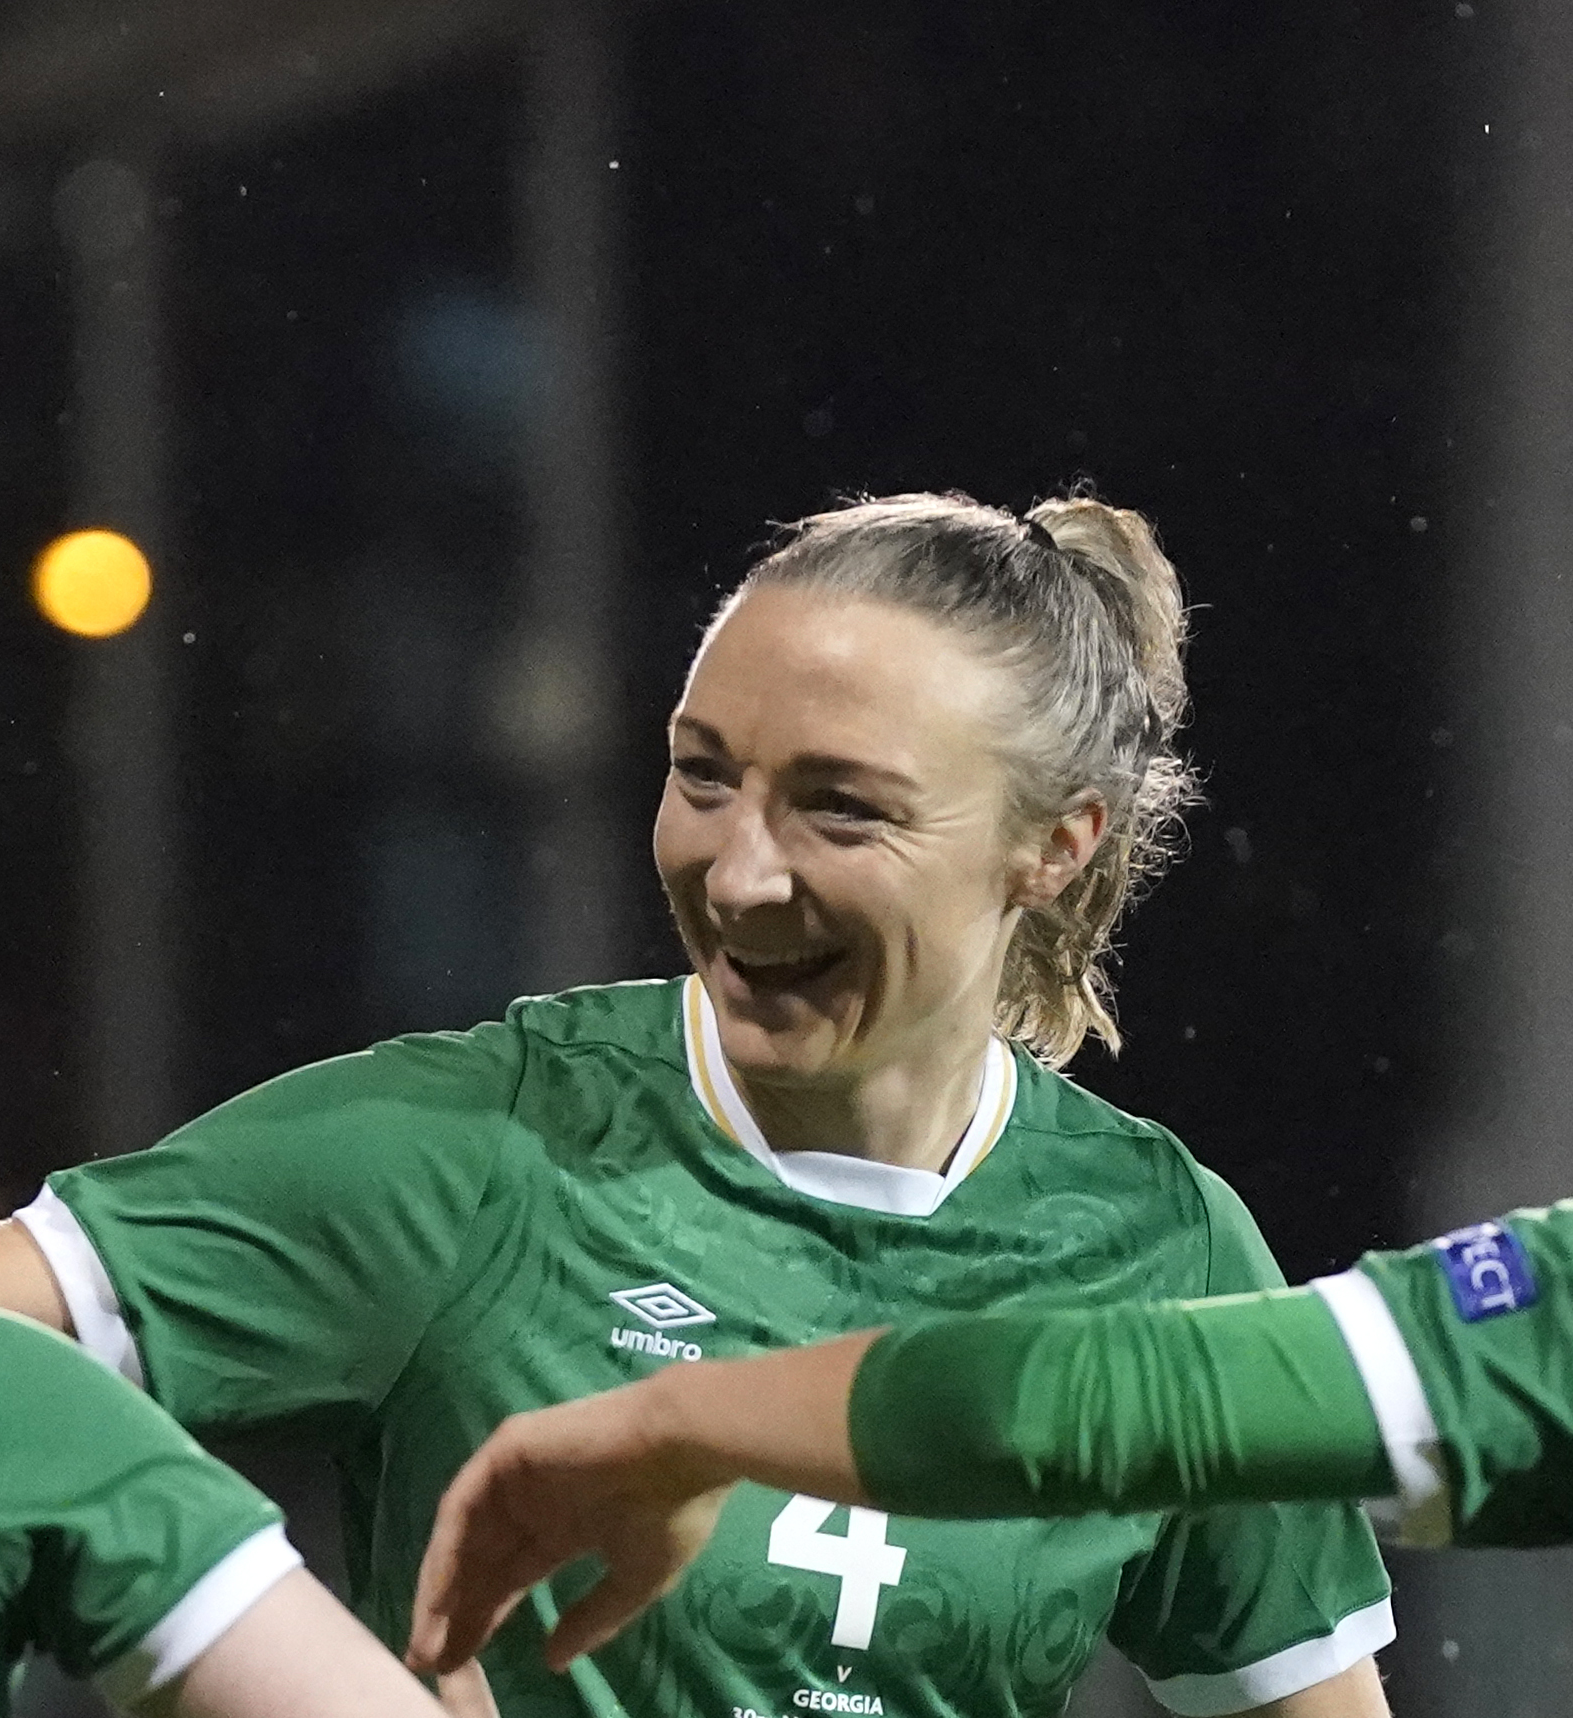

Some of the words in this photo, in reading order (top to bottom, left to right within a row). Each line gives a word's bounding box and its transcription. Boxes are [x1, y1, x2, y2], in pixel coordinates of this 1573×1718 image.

[610, 1326, 702, 1363] umbro
[767, 1493, 908, 1651] 4
[793, 1689, 884, 1716] GEORGIA
